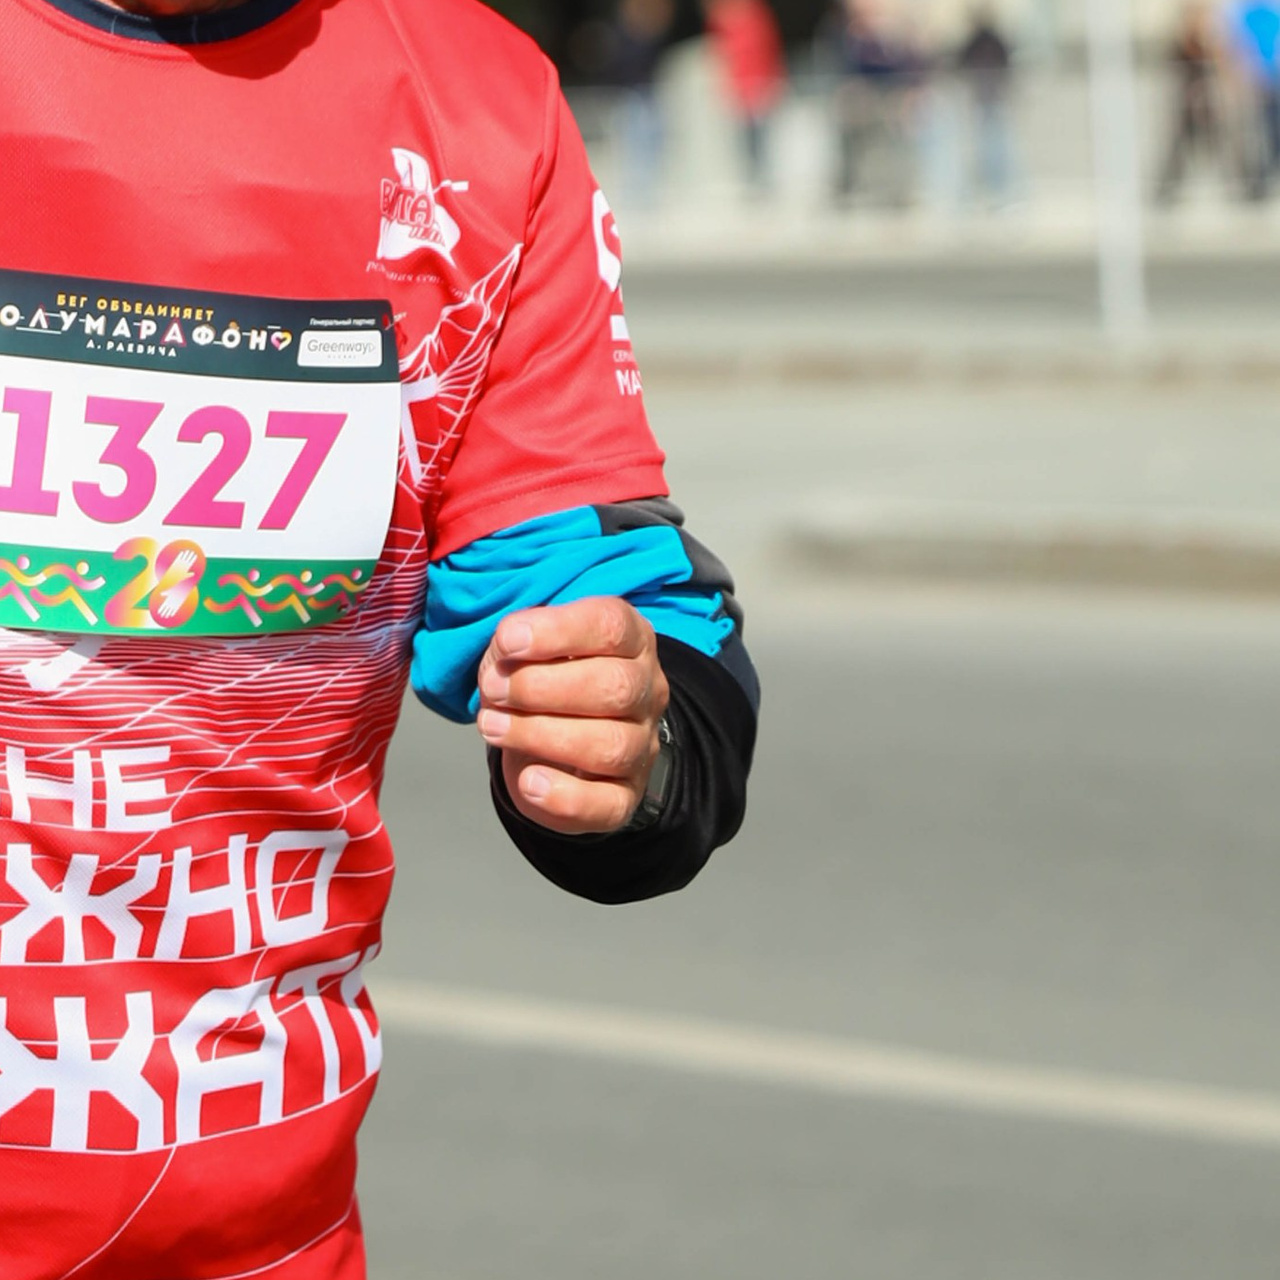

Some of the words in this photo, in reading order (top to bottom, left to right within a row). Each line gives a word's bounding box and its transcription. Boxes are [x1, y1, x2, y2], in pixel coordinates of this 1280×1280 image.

[57, 293, 88, 308] БЕГ
[96, 298, 214, 321] ОБЪЕДИНЯЕТ
[106, 340, 177, 357] РАЕВИЧА
[307, 339, 368, 355] Greenway
